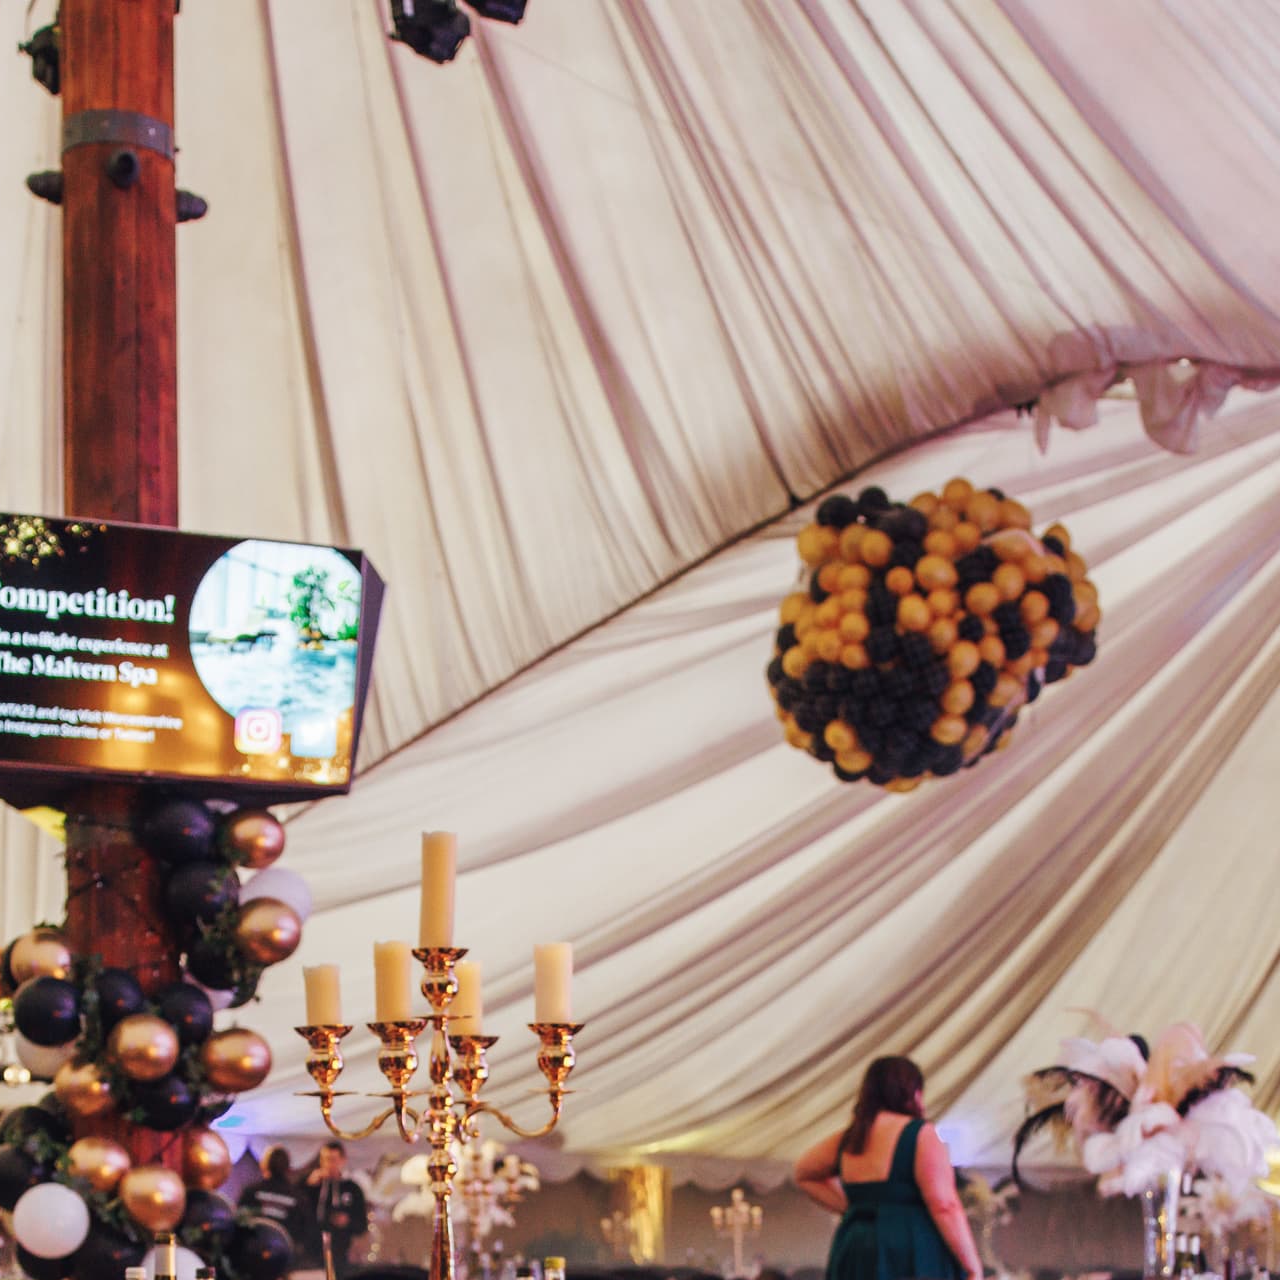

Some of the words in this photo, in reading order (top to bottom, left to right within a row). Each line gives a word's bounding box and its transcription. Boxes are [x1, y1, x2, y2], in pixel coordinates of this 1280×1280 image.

[11, 632, 21, 645] a
[22, 631, 77, 651] twilight
[78, 638, 152, 656] experience
[152, 643, 168, 658] at
[32, 653, 117, 681] Malvern
[119, 661, 158, 688] Spa
